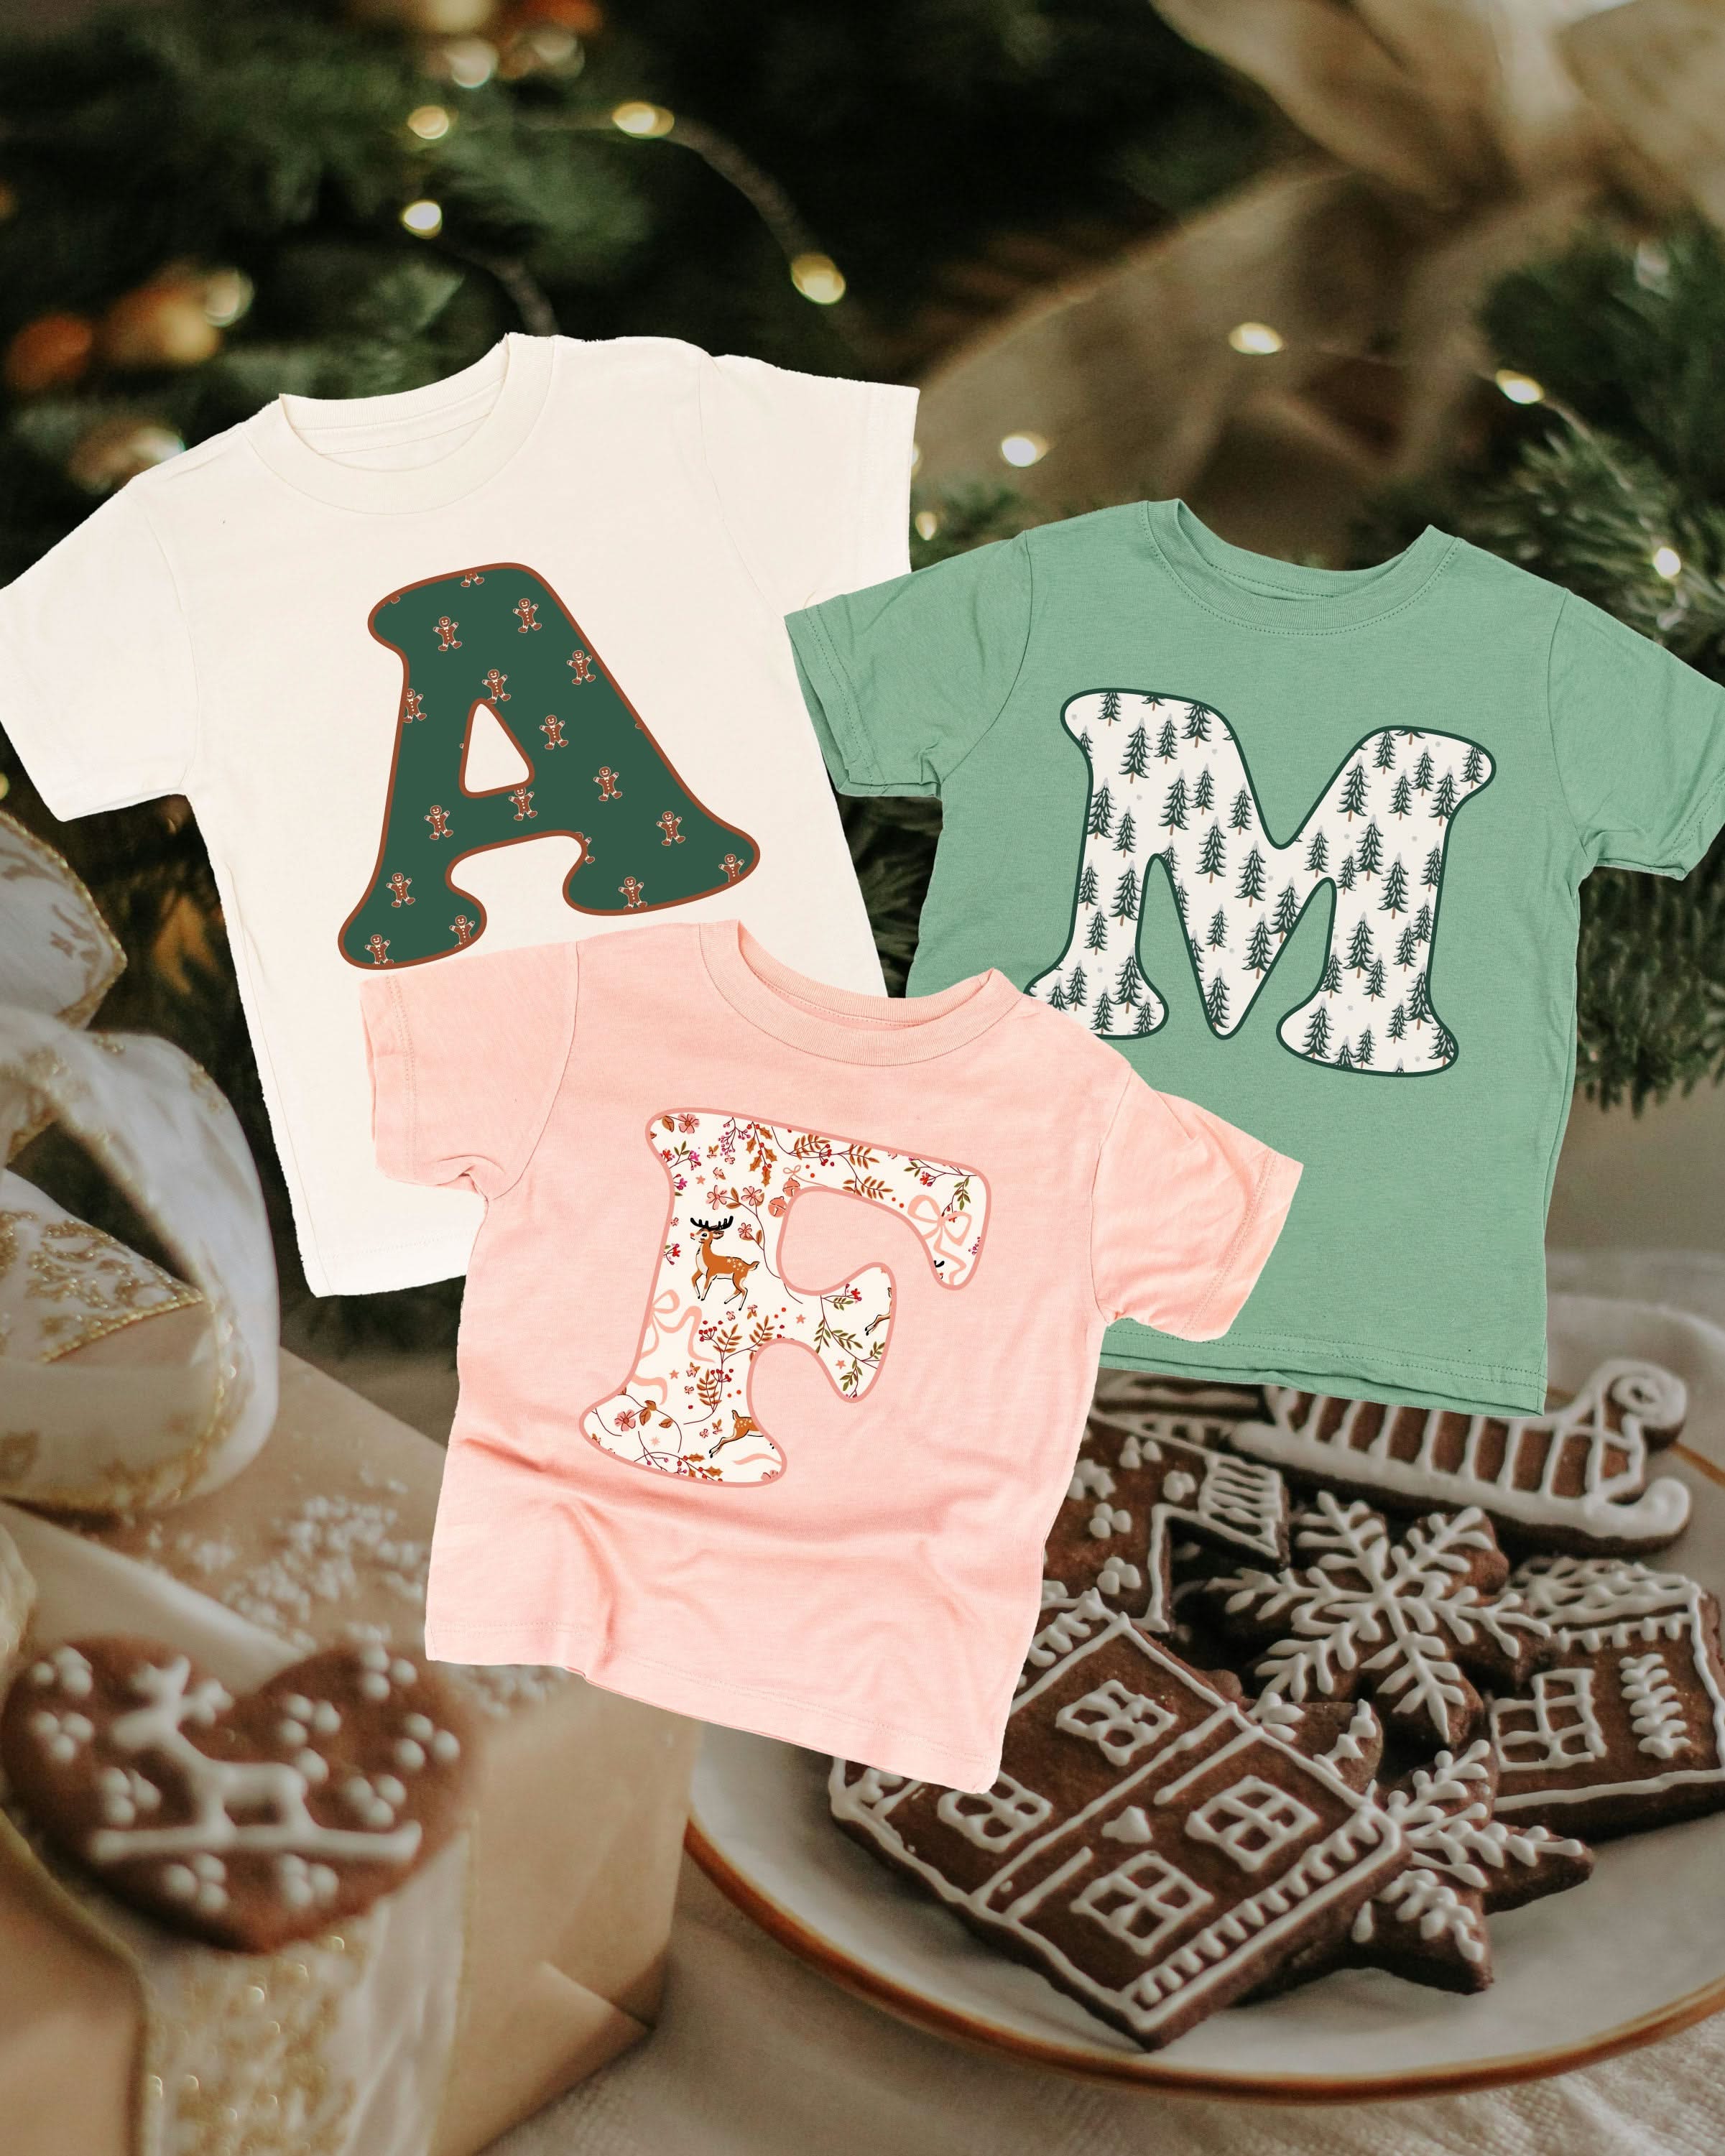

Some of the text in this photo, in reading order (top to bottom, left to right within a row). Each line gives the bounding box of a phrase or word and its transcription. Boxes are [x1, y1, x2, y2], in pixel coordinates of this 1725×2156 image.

[338, 563, 760, 970] A
[1023, 688, 1497, 1077] M
[579, 1107, 991, 1488] F
